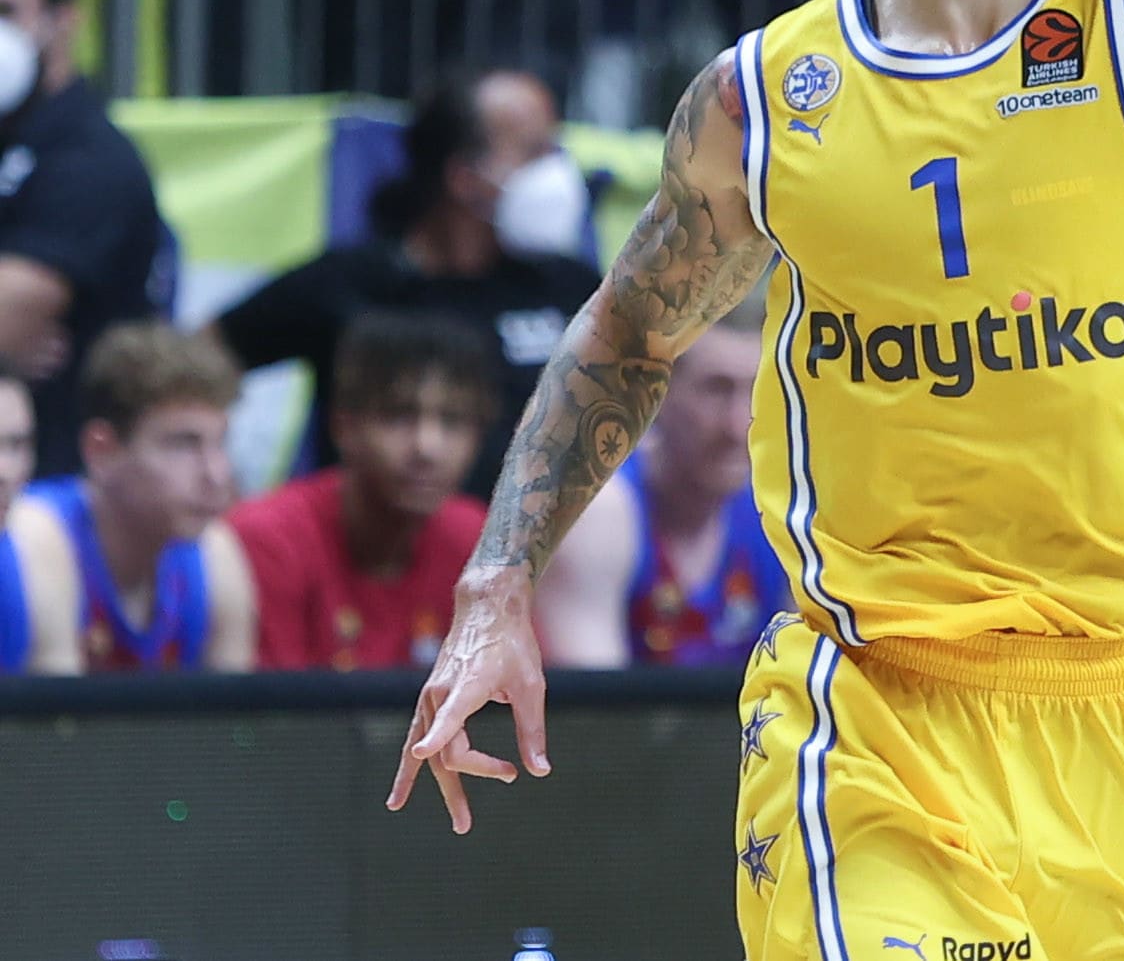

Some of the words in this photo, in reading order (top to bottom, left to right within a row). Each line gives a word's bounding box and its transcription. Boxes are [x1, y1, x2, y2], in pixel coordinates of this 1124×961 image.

[1027, 67, 1078, 80] AIRLINES
[1028, 58, 1078, 73] TURKISH
[910, 156, 970, 280] 1
[942, 933, 1032, 961] Rapyd
